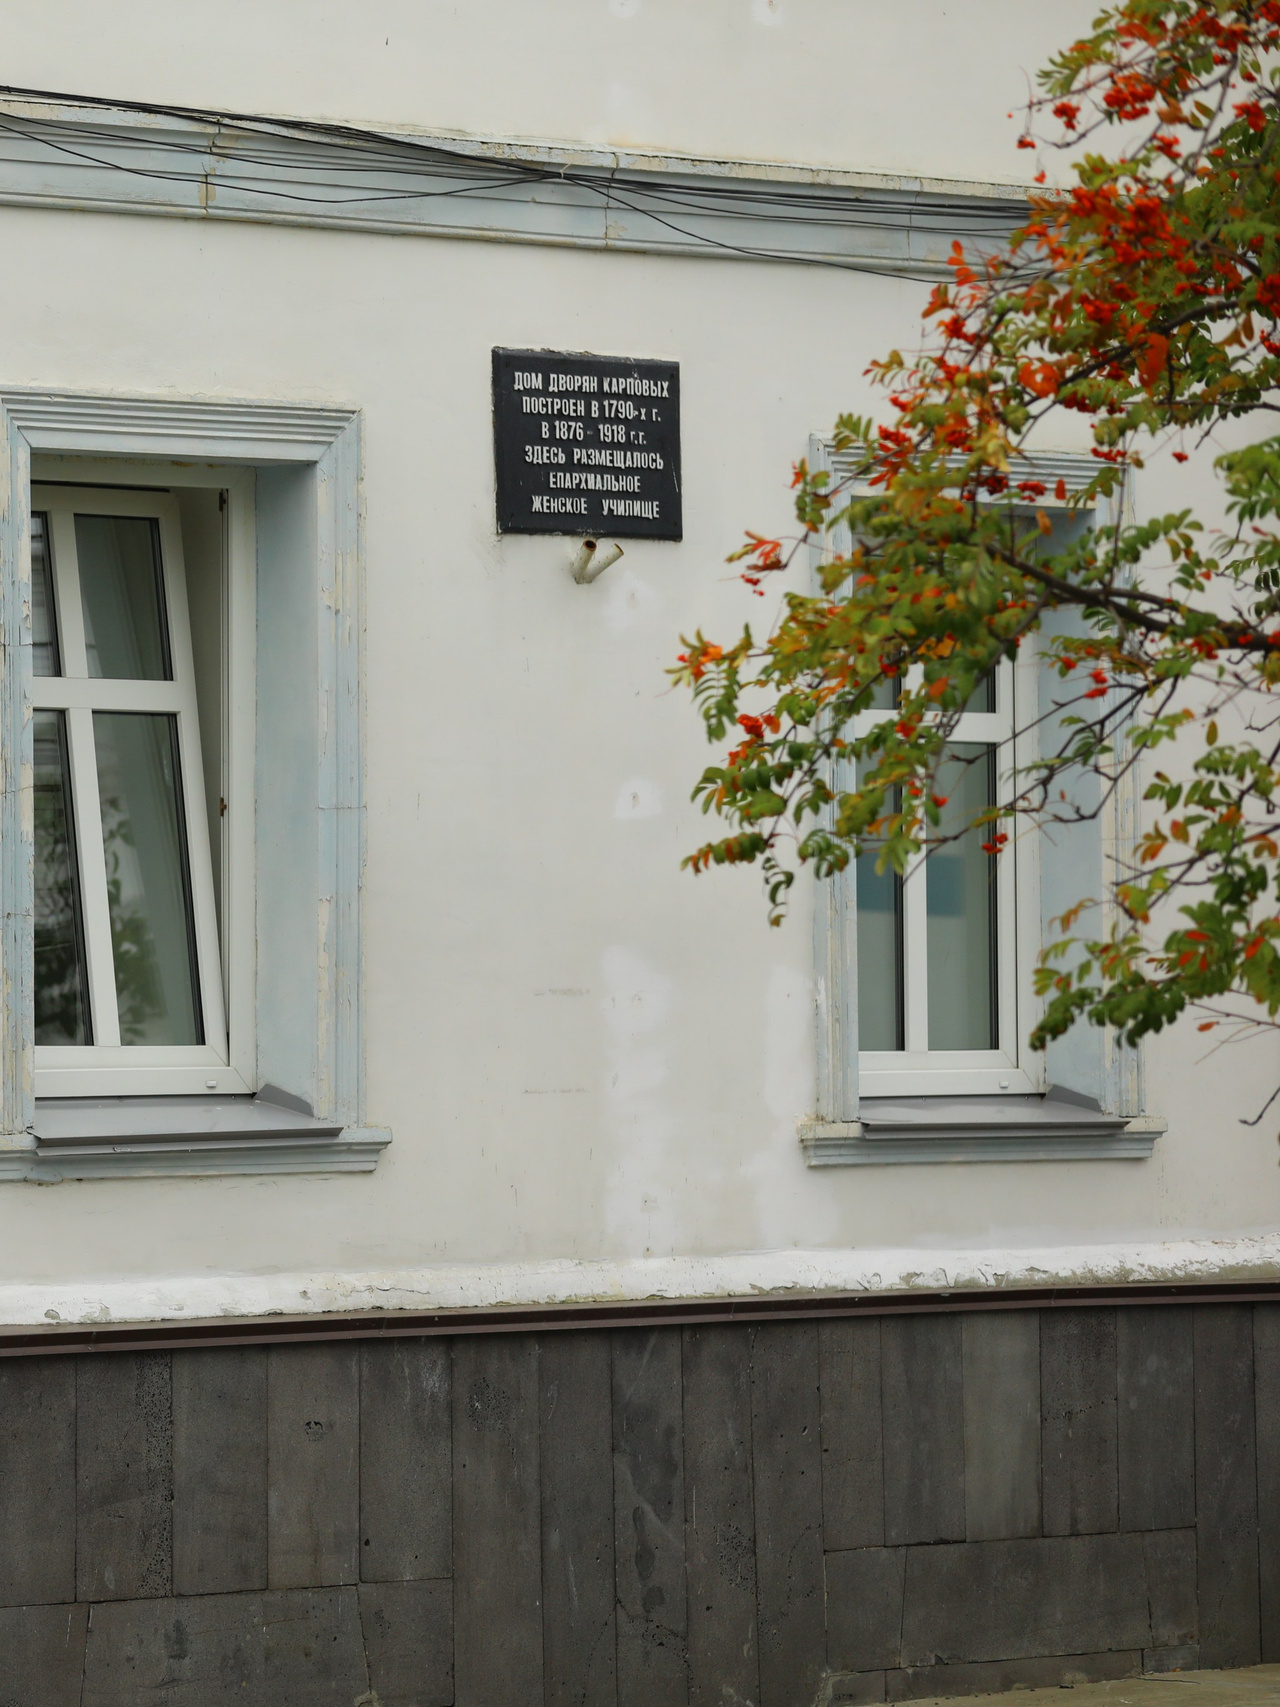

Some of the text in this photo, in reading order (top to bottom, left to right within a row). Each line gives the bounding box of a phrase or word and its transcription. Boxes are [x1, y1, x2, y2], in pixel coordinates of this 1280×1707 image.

[514, 372, 668, 397] ДОМ ДВОРЯН КАРПОВЫХ
[522, 396, 584, 417] ПОСТРОЕН
[591, 401, 599, 417] В
[542, 422, 549, 438] В
[555, 421, 583, 440] 1876
[599, 424, 625, 443] 1918
[525, 445, 663, 469] ЗДЕСЬ РАЗМЕЩАЛОСЬ
[550, 472, 640, 492] ЕПАРХИАЛЬНОЕ
[532, 495, 659, 519] ЖЕНСКОЕ УЧИЛИЩЕ
